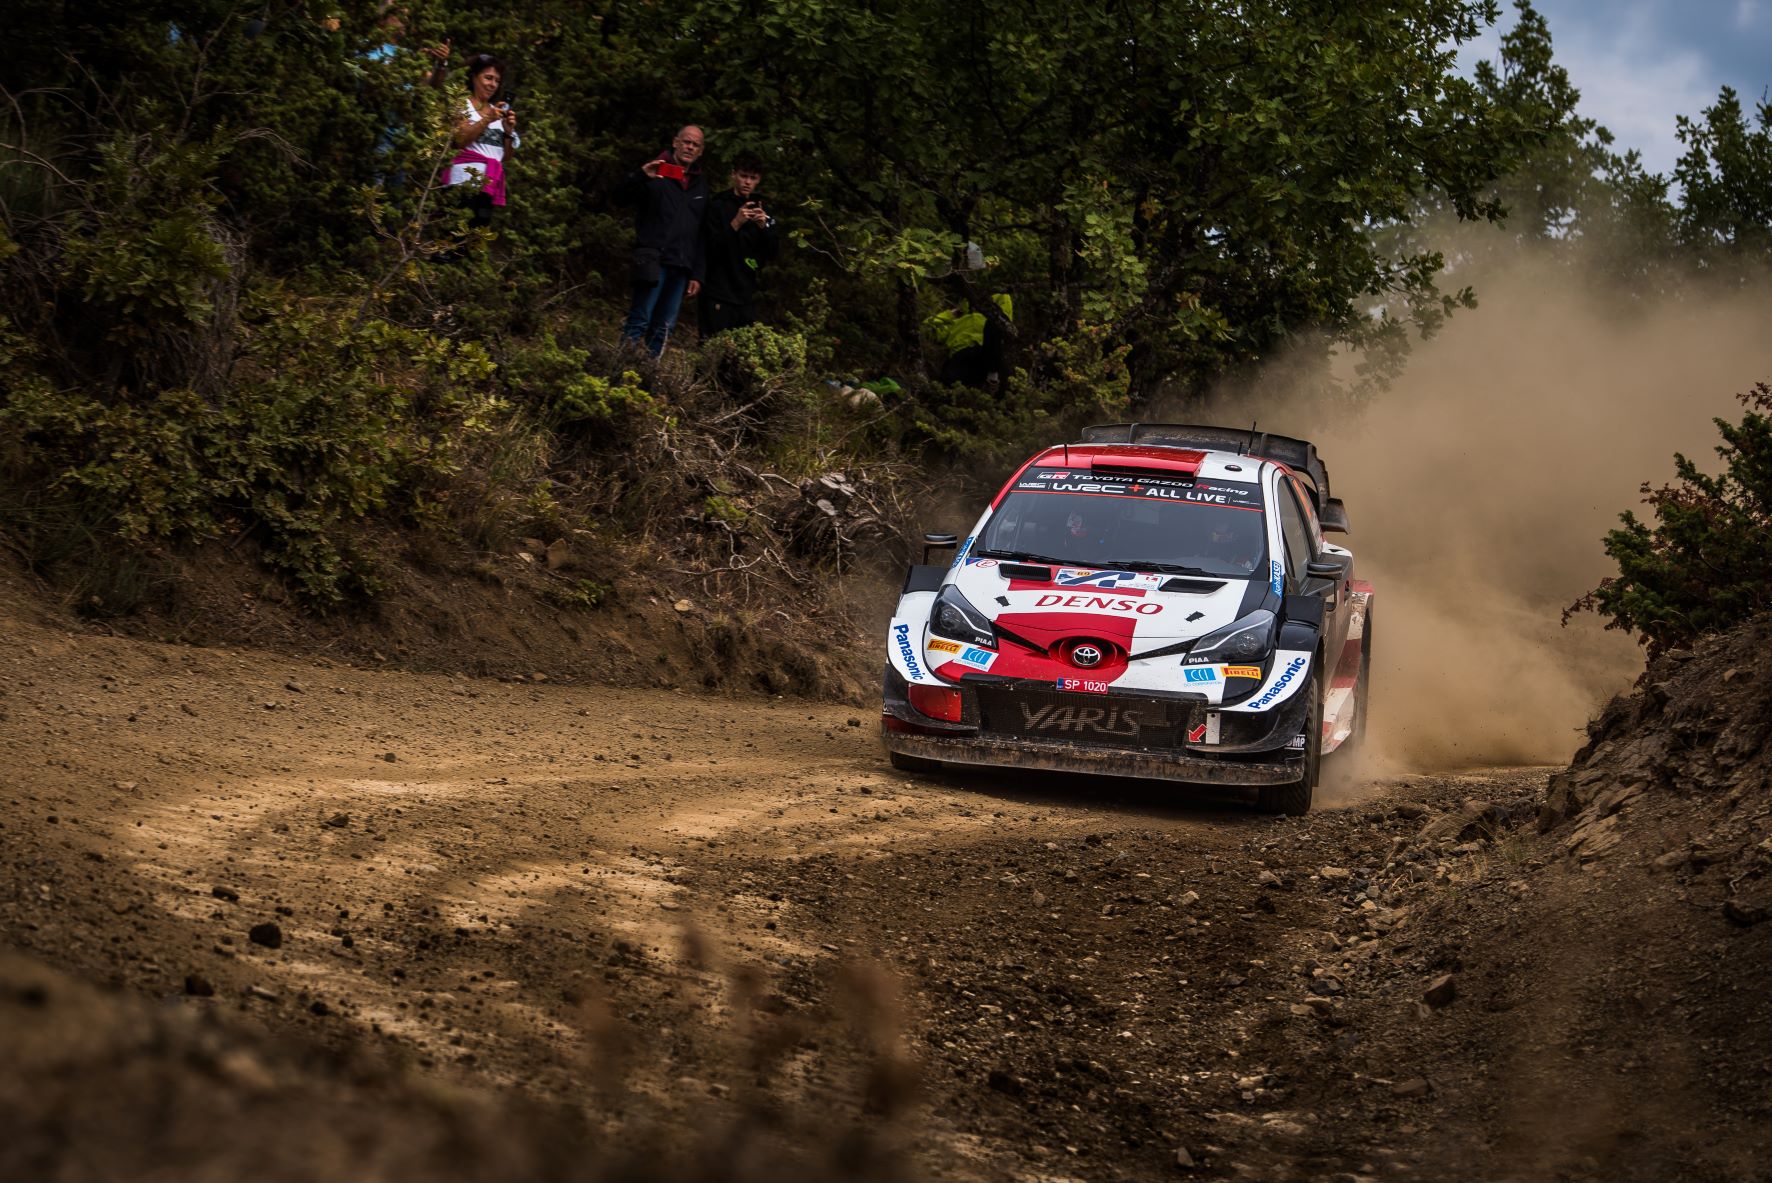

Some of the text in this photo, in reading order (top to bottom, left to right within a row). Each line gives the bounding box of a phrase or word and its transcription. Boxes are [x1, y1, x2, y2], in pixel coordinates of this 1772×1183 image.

[1072, 474, 1133, 483] TOYOTA
[1137, 478, 1194, 488] GAZOO
[1196, 483, 1249, 496] Racing
[1146, 487, 1180, 498] ALL
[1186, 491, 1226, 503] LIVE
[1035, 594, 1164, 615] DENSO
[928, 640, 960, 653] PIRELLI
[974, 636, 993, 647] PIAA
[893, 624, 924, 681] Panasonic
[1188, 656, 1210, 664] PIAA
[1223, 667, 1259, 677] PIRELLI
[1064, 679, 1107, 692] SP 1020
[1247, 657, 1306, 710] Panasonic
